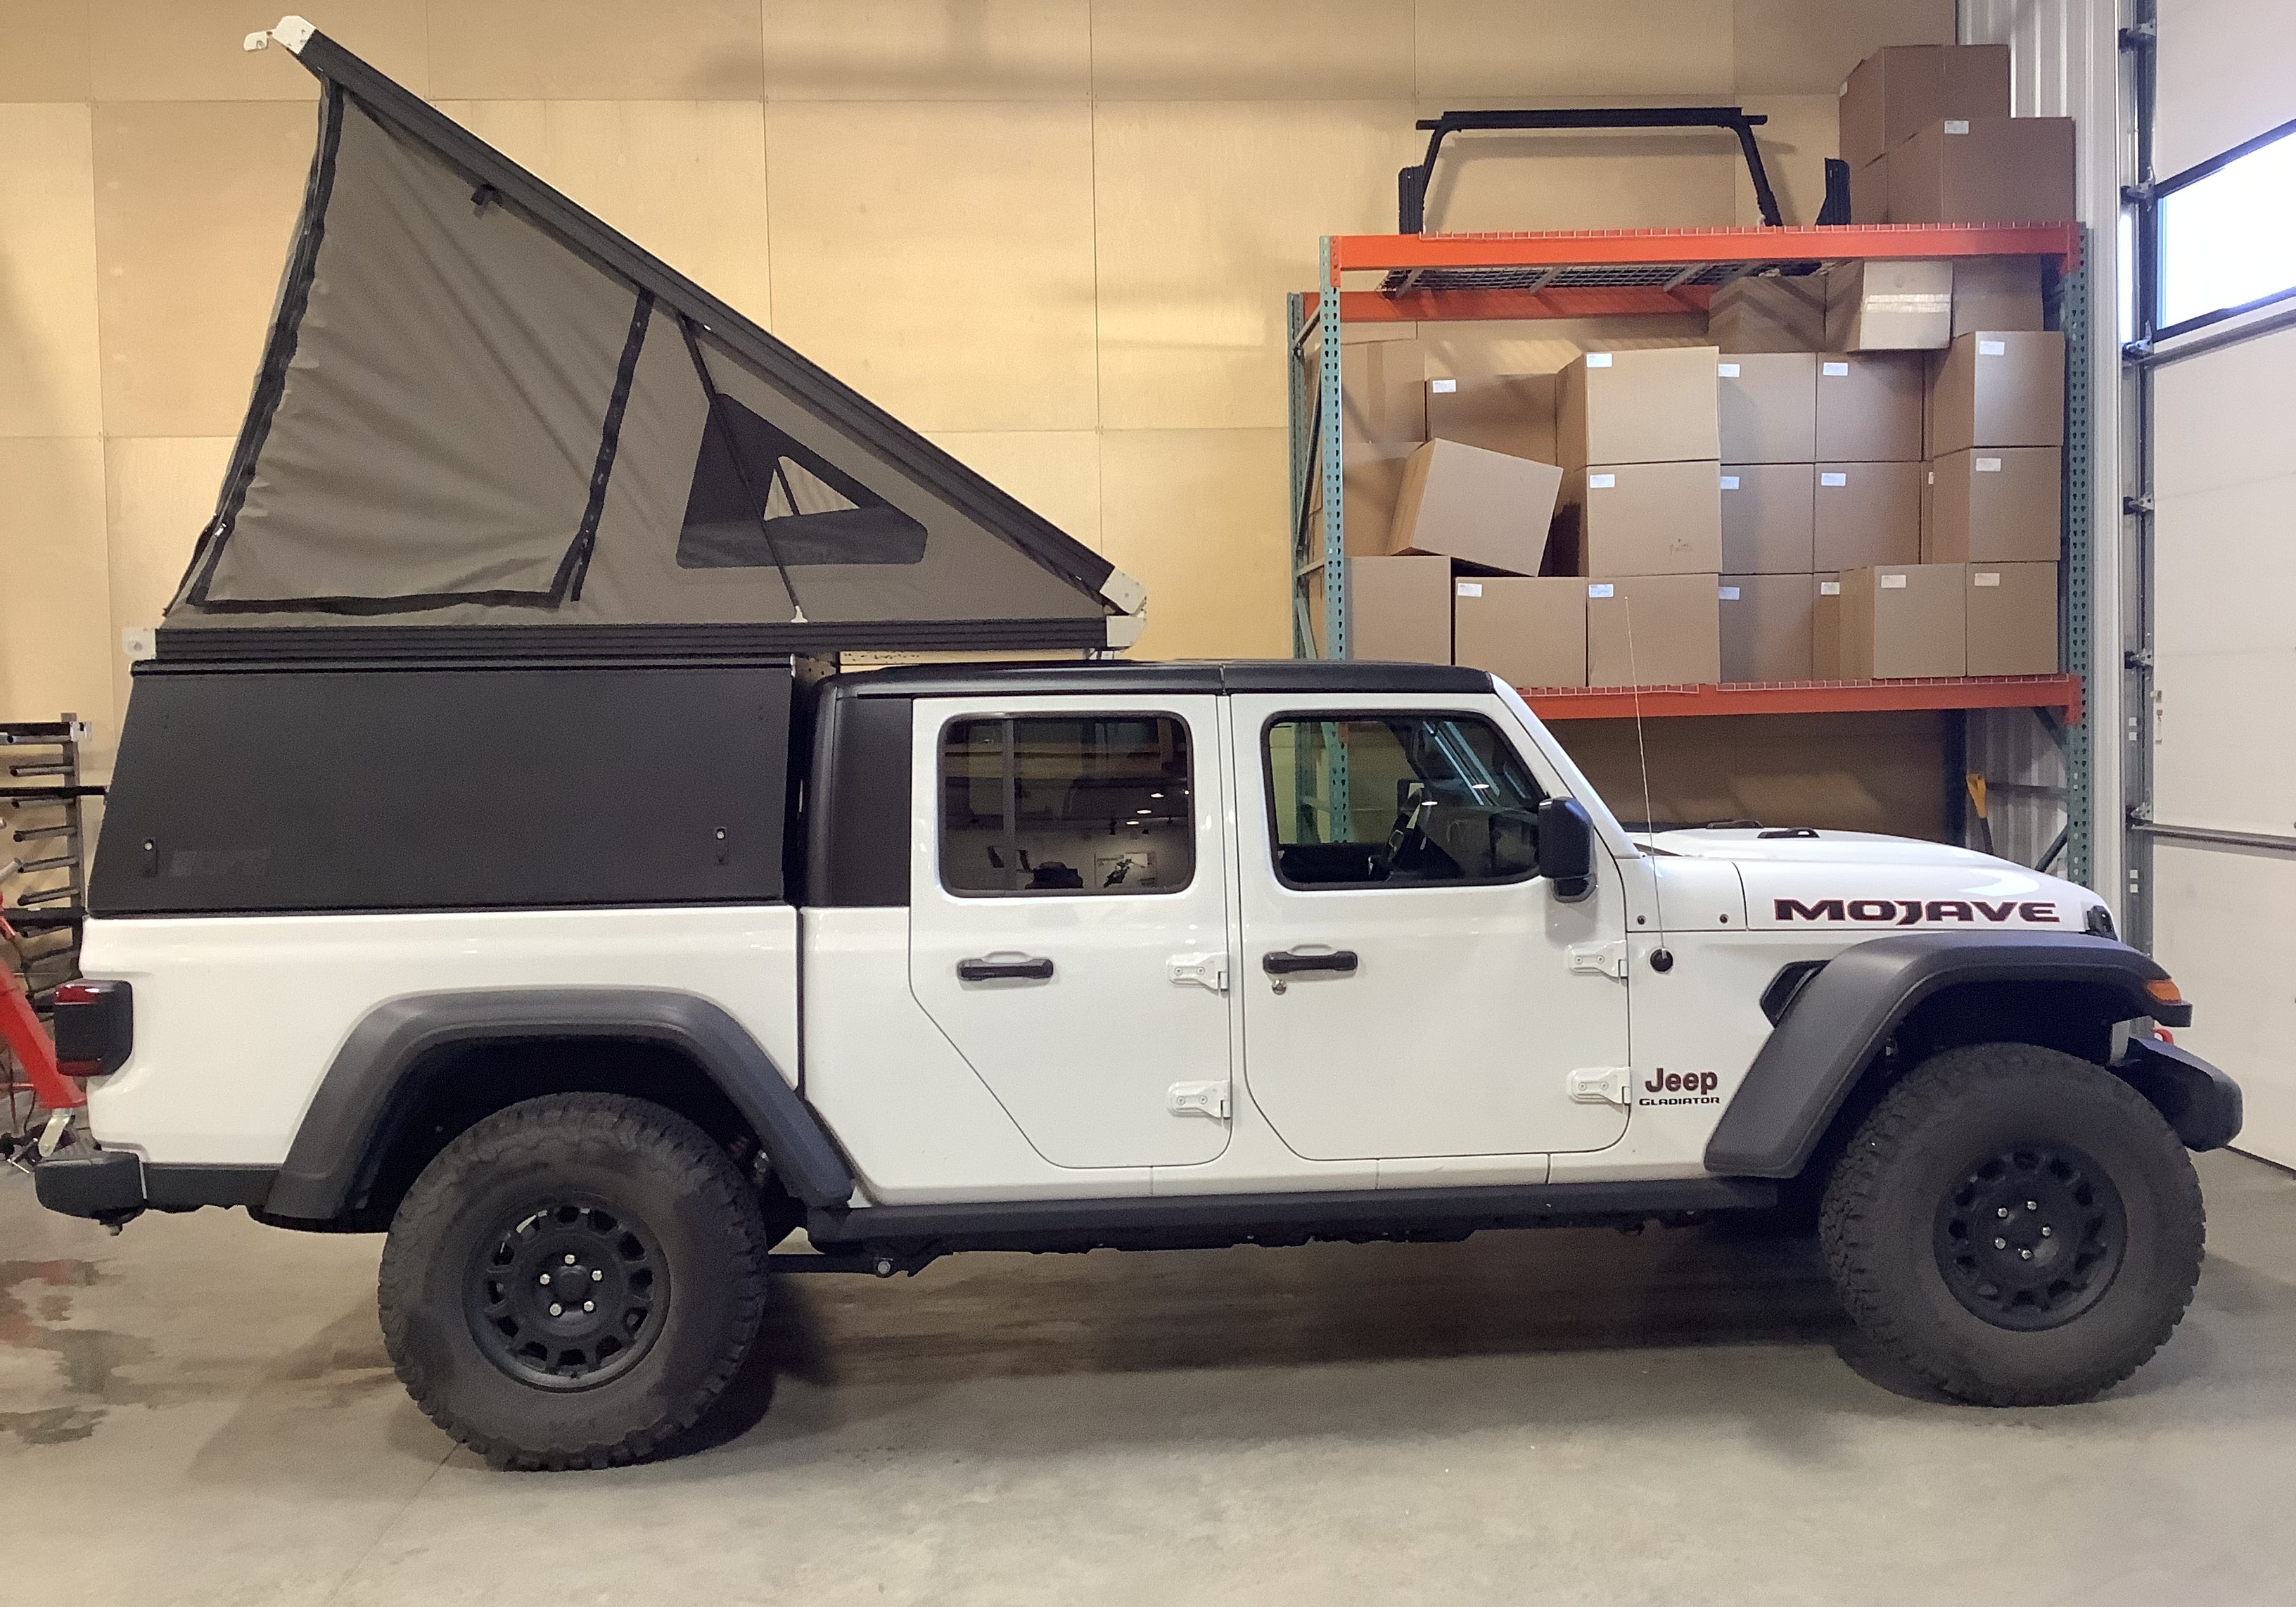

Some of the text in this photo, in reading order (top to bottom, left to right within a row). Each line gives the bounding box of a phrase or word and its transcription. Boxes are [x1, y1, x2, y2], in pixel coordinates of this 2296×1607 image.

[1773, 898, 2060, 926] MOJAVE
[1645, 1067, 1718, 1095] Jeep
[1638, 1097, 1720, 1105] GLADIATOR
